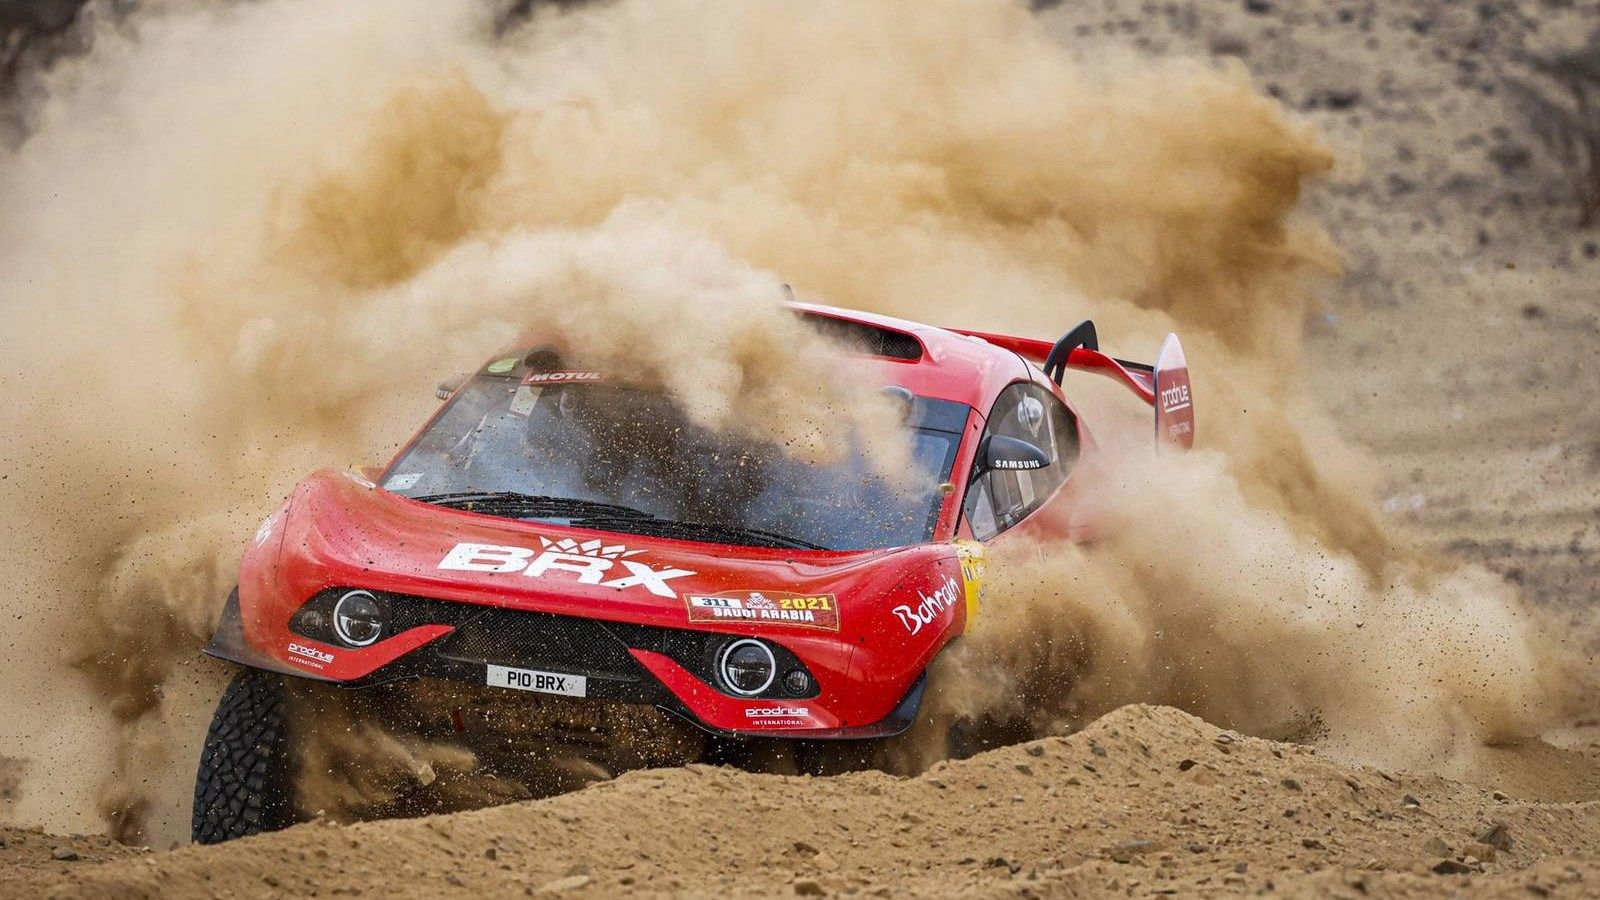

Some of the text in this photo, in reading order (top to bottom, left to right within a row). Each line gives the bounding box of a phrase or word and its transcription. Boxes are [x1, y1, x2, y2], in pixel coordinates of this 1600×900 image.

[529, 371, 601, 383] MOTUL
[994, 459, 1041, 469] SAMSUNG
[437, 542, 697, 599] BRX
[701, 597, 730, 607] 311
[780, 597, 832, 611] 2021
[892, 574, 961, 636] Bahrain
[713, 608, 815, 621] SAUDI ARABIA
[288, 643, 335, 663] prodrive
[288, 656, 324, 670] INTERNATIONAL
[535, 675, 566, 691] BRX
[745, 706, 809, 717] prodrive
